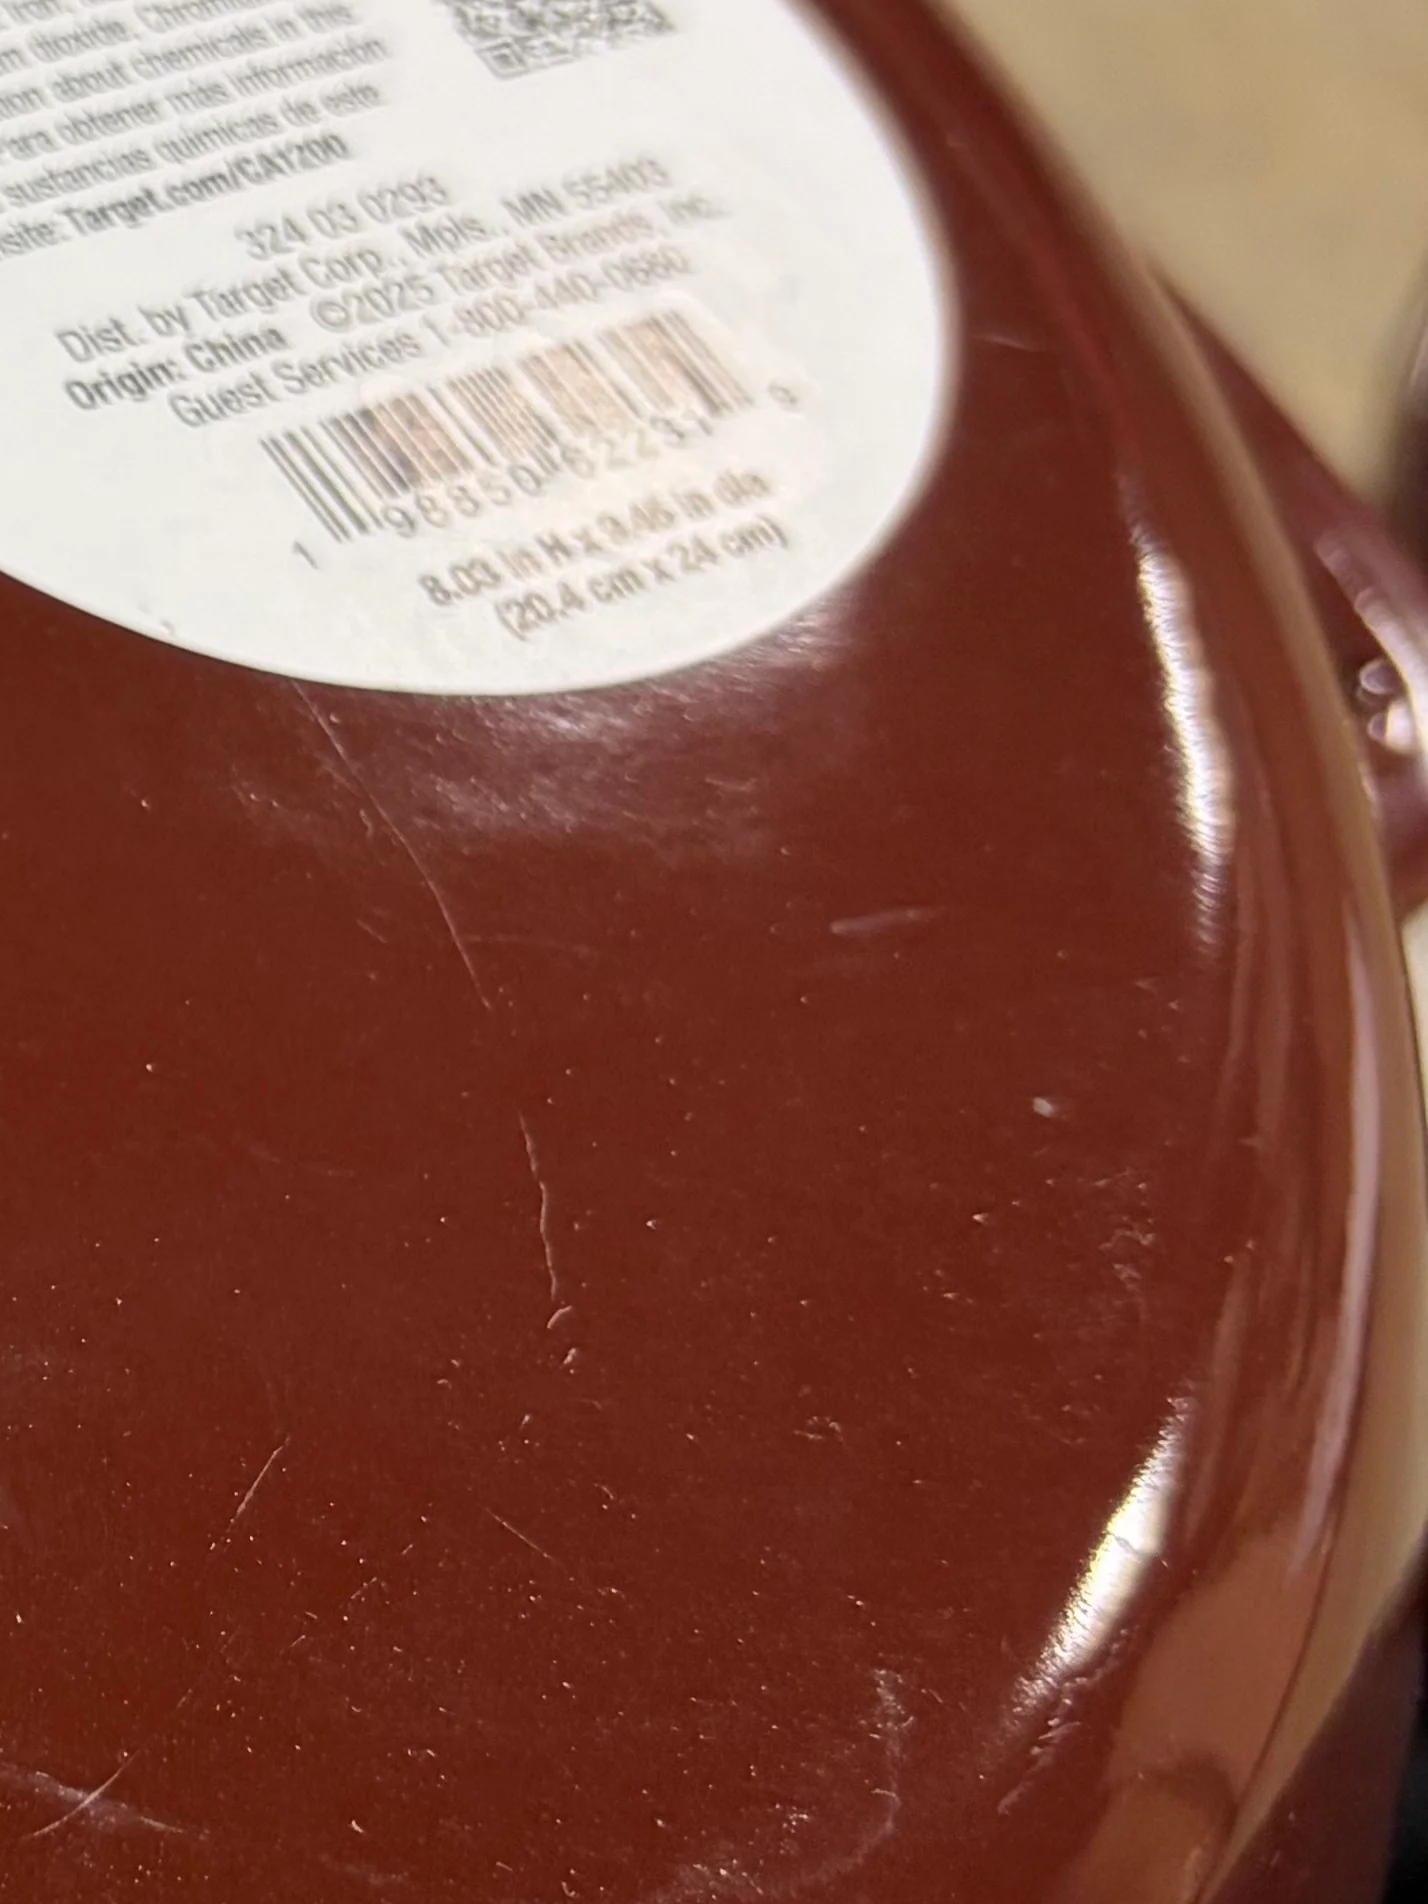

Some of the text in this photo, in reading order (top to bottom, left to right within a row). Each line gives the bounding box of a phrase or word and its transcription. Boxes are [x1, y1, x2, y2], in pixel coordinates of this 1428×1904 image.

[46, 61, 134, 104] about
[128, 22, 277, 82] chemicals
[267, 14, 307, 43] in
[295, 0, 361, 35] this
[277, 94, 325, 129] de
[318, 82, 387, 118] este
[53, 95, 163, 145] obtener
[54, 130, 355, 237] Target.com/CA1200
[233, 170, 452, 263] 324 03 0293
[55, 317, 146, 363] Dist.
[138, 302, 195, 339] by
[181, 264, 310, 322] Target
[501, 185, 570, 228] MN
[63, 356, 187, 412] Origin:
[182, 325, 292, 373] China
[308, 272, 438, 334] ©2025
[427, 241, 546, 297] Target
[167, 242, 701, 428] Guest Services 1-800-440-0680
[290, 538, 321, 571] 1
[381, 459, 546, 540] 98850
[417, 557, 503, 608] 8.03
[495, 544, 545, 581] in
[536, 527, 578, 567] H
[568, 526, 604, 557] x
[663, 484, 717, 520] in
[709, 466, 775, 506] dia
[493, 511, 792, 643] (20.4 cm x 24 cm)
